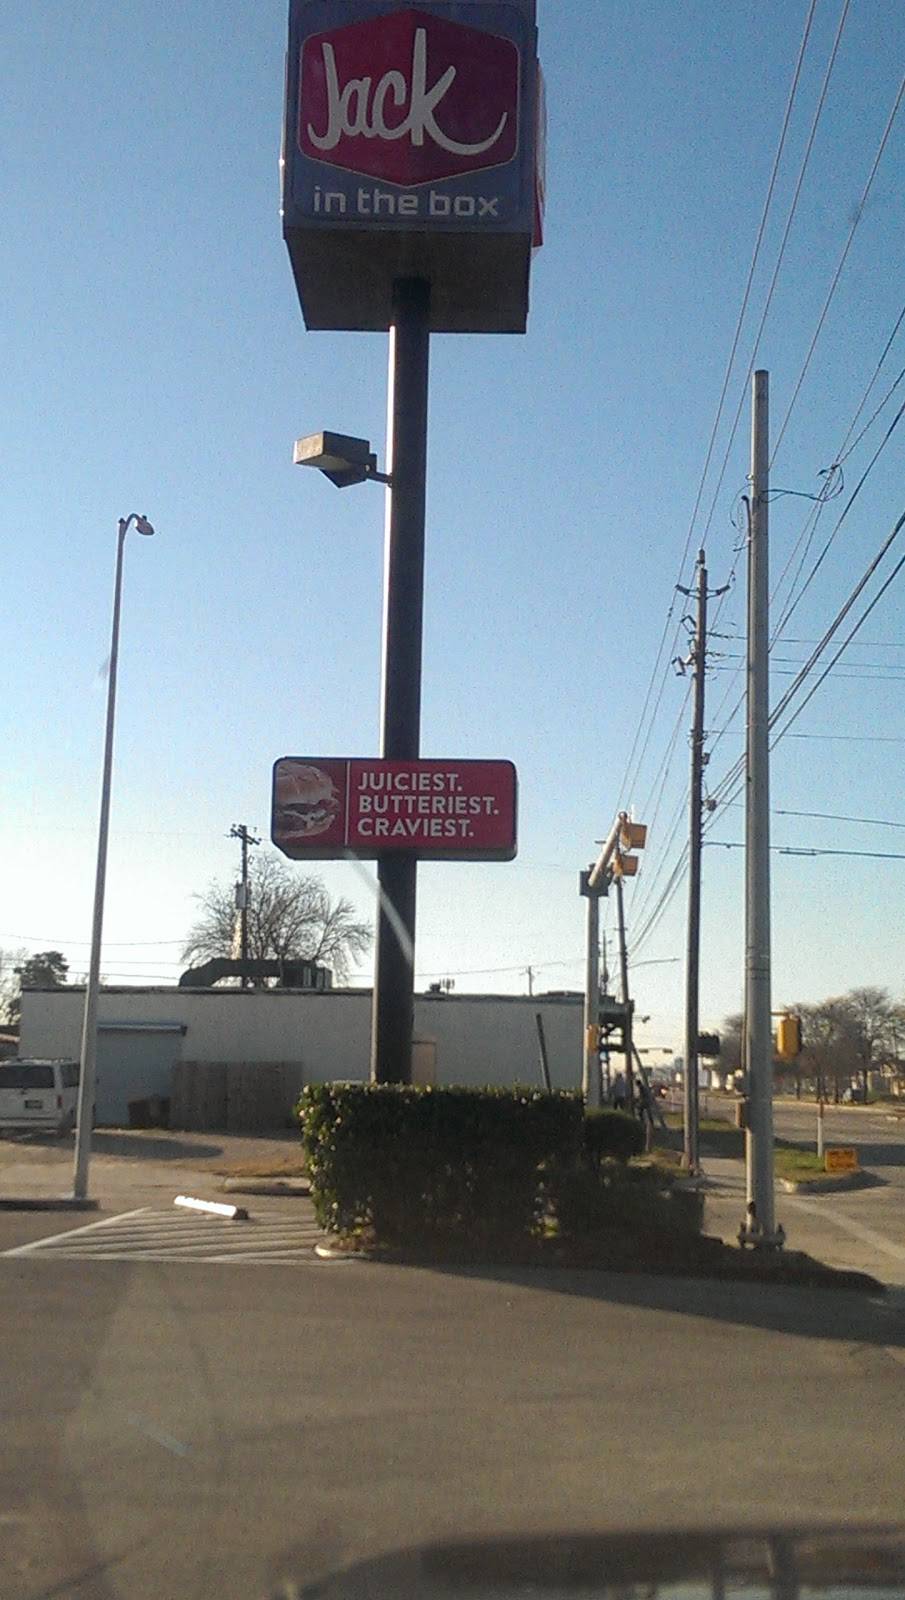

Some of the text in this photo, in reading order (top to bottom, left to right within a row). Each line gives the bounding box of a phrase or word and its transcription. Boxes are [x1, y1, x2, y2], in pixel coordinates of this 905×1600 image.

[307, 28, 508, 155] Jack
[313, 186, 499, 216] in the box
[357, 772, 463, 792] JUICIEST.
[358, 795, 500, 815] BUTTERIEST.
[357, 818, 475, 837] CRAVIEST.
